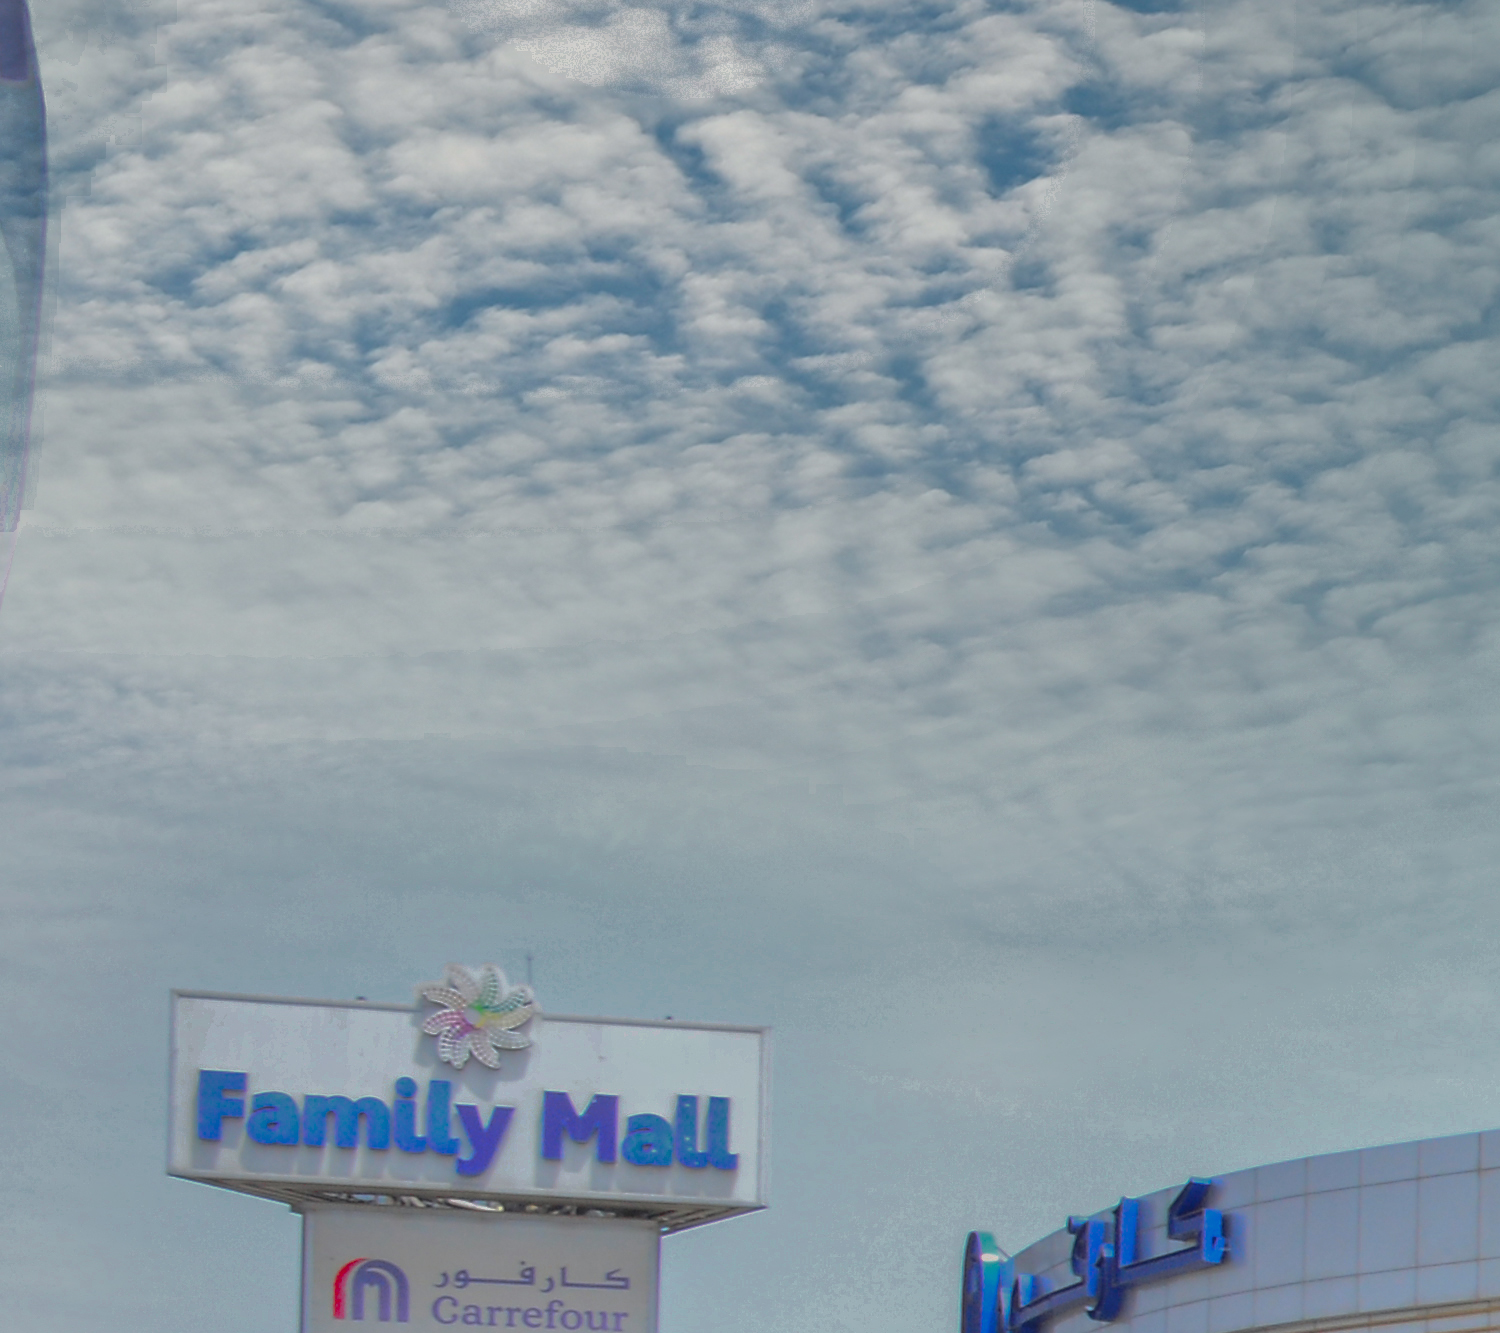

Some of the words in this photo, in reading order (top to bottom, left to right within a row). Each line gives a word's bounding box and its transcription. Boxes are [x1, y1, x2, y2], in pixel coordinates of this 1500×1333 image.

[197, 1068, 515, 1176] Family
[542, 1089, 739, 1170] Mall
[431, 1295, 629, 1332] Carrefour
